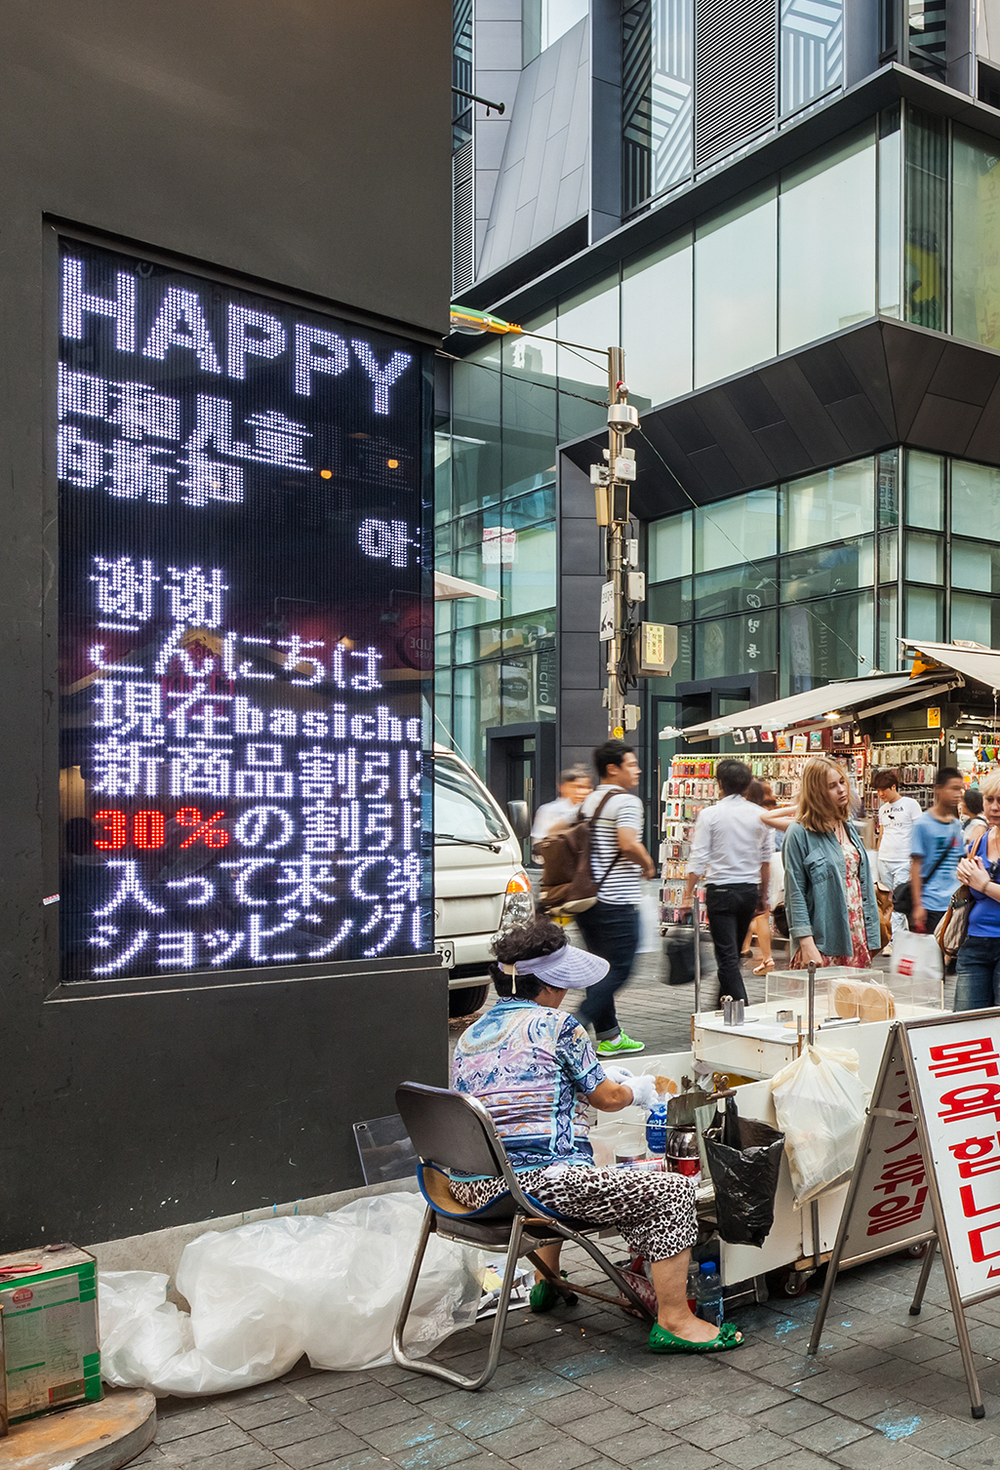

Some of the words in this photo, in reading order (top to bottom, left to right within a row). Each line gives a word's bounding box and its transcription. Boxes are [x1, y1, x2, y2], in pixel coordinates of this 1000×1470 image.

[62, 256, 412, 416] HAPPY
[90, 555, 230, 629] 谢谢
[90, 620, 383, 692] こんにちは
[90, 904, 422, 976] ショッピング
